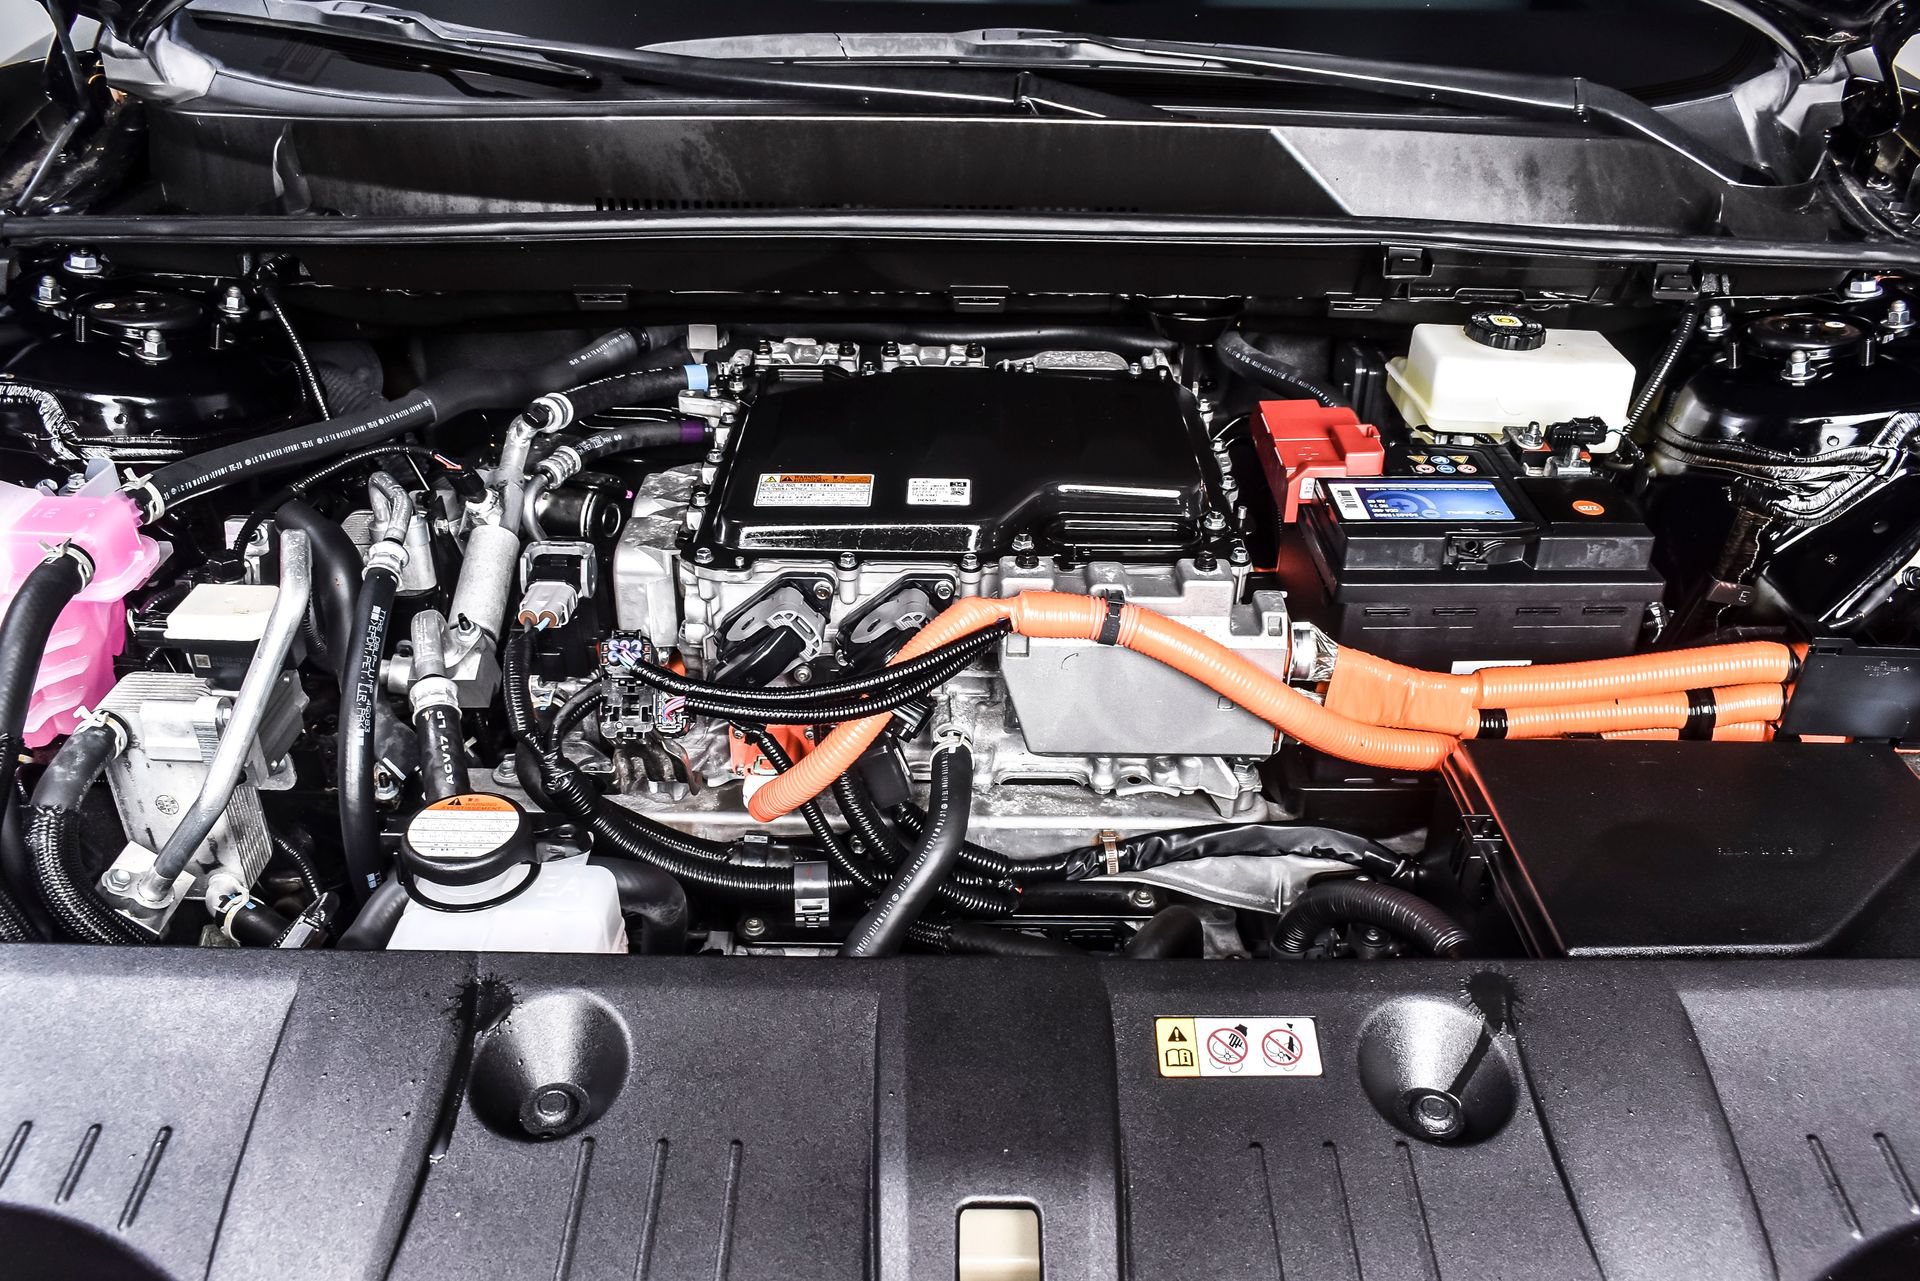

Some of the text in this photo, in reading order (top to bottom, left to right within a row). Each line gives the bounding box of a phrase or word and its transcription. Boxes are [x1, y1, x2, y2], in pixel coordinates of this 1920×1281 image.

[1738, 590, 1750, 602] E
[436, 709, 454, 784] ACV17 LP
[926, 828, 941, 850] WATER
[868, 917, 884, 937] WATER
